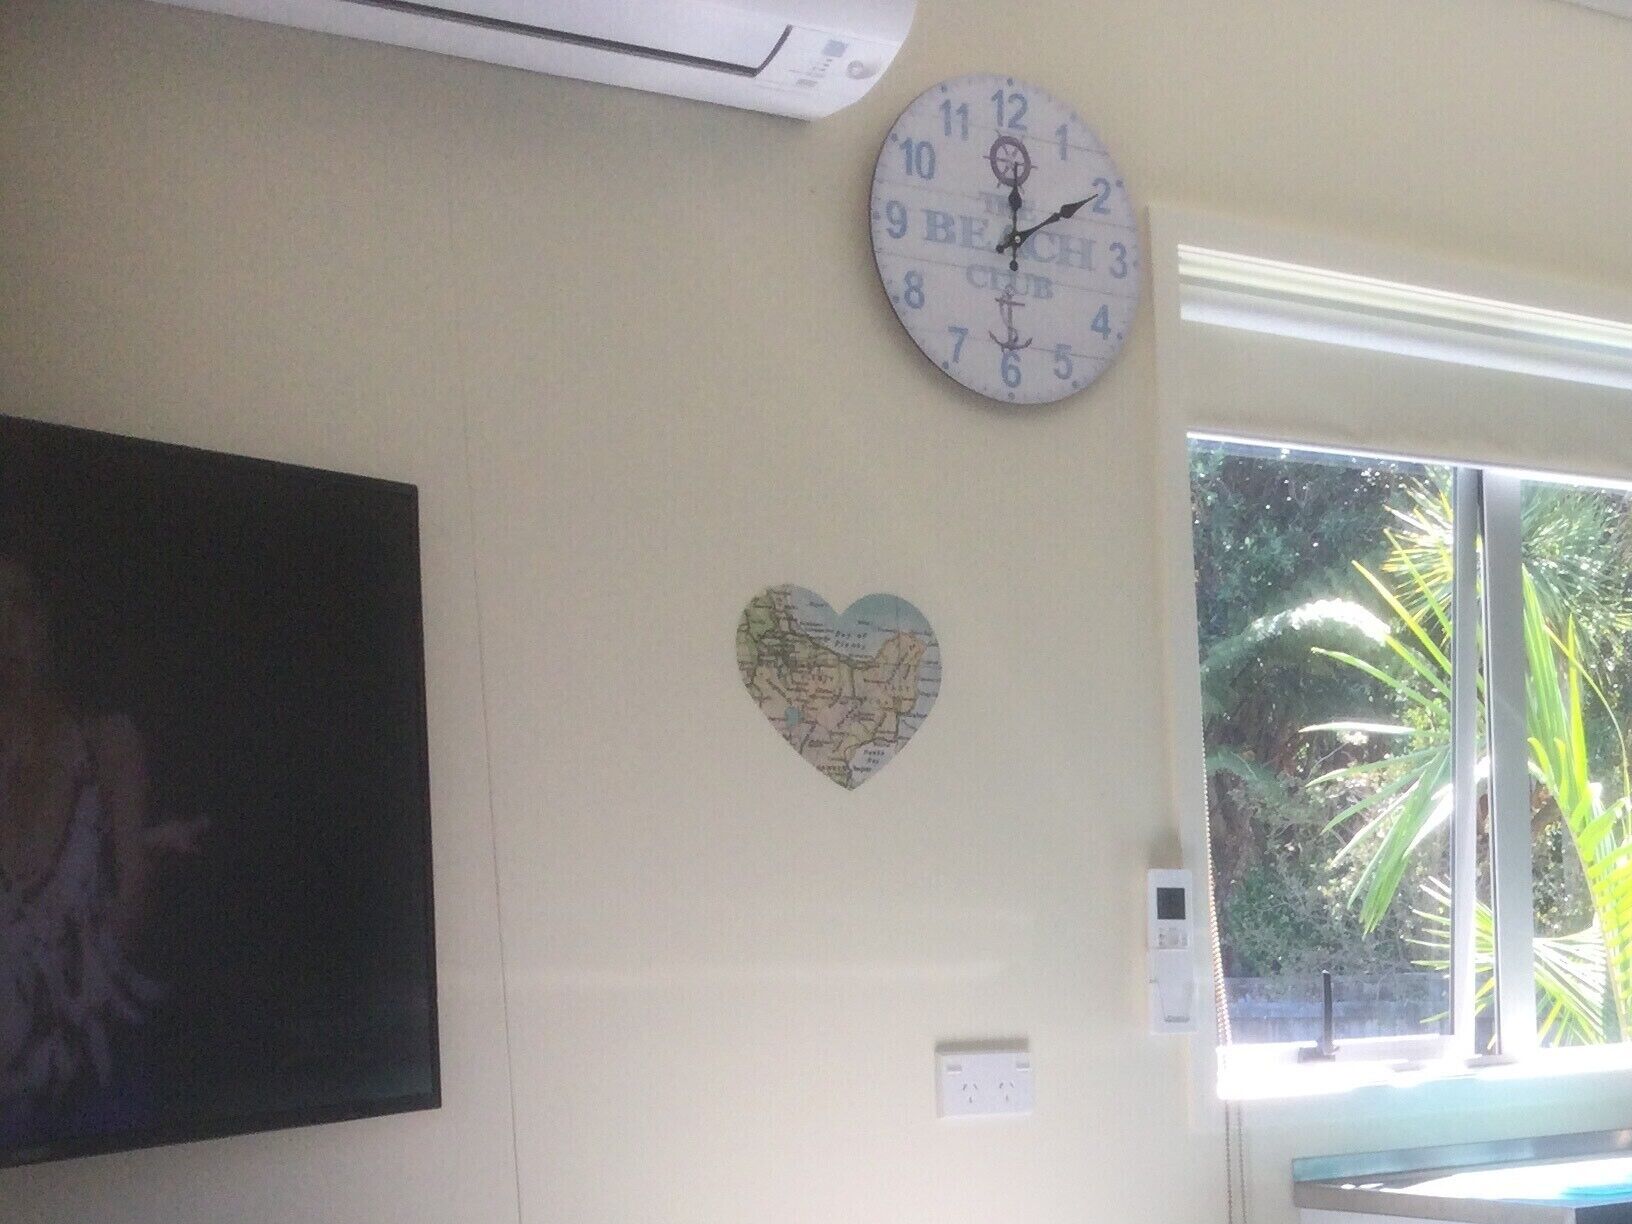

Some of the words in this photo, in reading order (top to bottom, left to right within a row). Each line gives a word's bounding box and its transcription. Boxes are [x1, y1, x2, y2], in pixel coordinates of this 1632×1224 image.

[938, 99, 969, 141] 11
[991, 89, 1029, 131] 12
[900, 137, 936, 180] 10
[1054, 123, 1069, 161] 1
[1091, 177, 1112, 215] 2
[885, 200, 909, 239] 9
[921, 208, 1096, 272] BEACH
[1108, 242, 1129, 280] 3
[903, 269, 926, 310] 8
[1090, 304, 1112, 341] 4
[947, 326, 969, 363] 7
[1053, 343, 1074, 381] 5
[1000, 350, 1022, 388] 6
